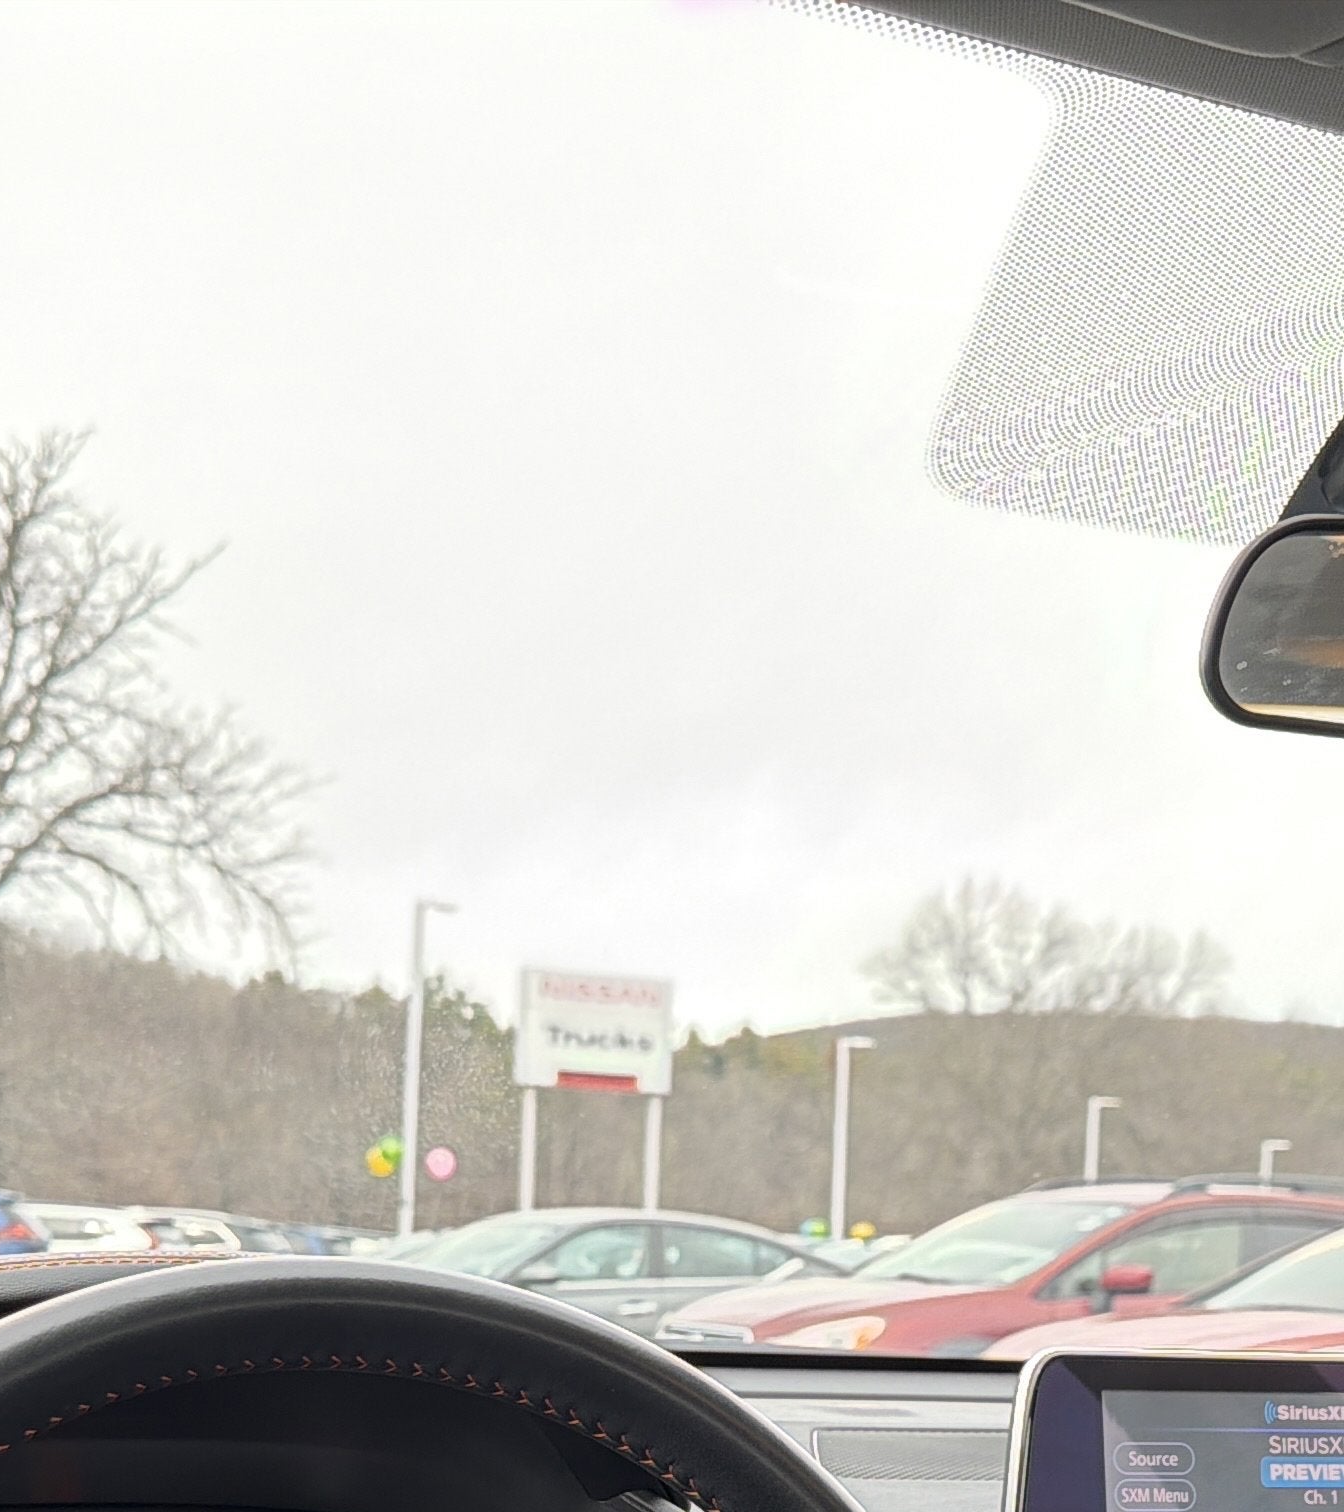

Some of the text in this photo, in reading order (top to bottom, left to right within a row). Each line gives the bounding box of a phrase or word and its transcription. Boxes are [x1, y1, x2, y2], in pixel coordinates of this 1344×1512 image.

[1129, 1451, 1178, 1466] Source
[1121, 1488, 1189, 1503] SXM Menu
[1304, 1489, 1338, 1505] Ch. 1
